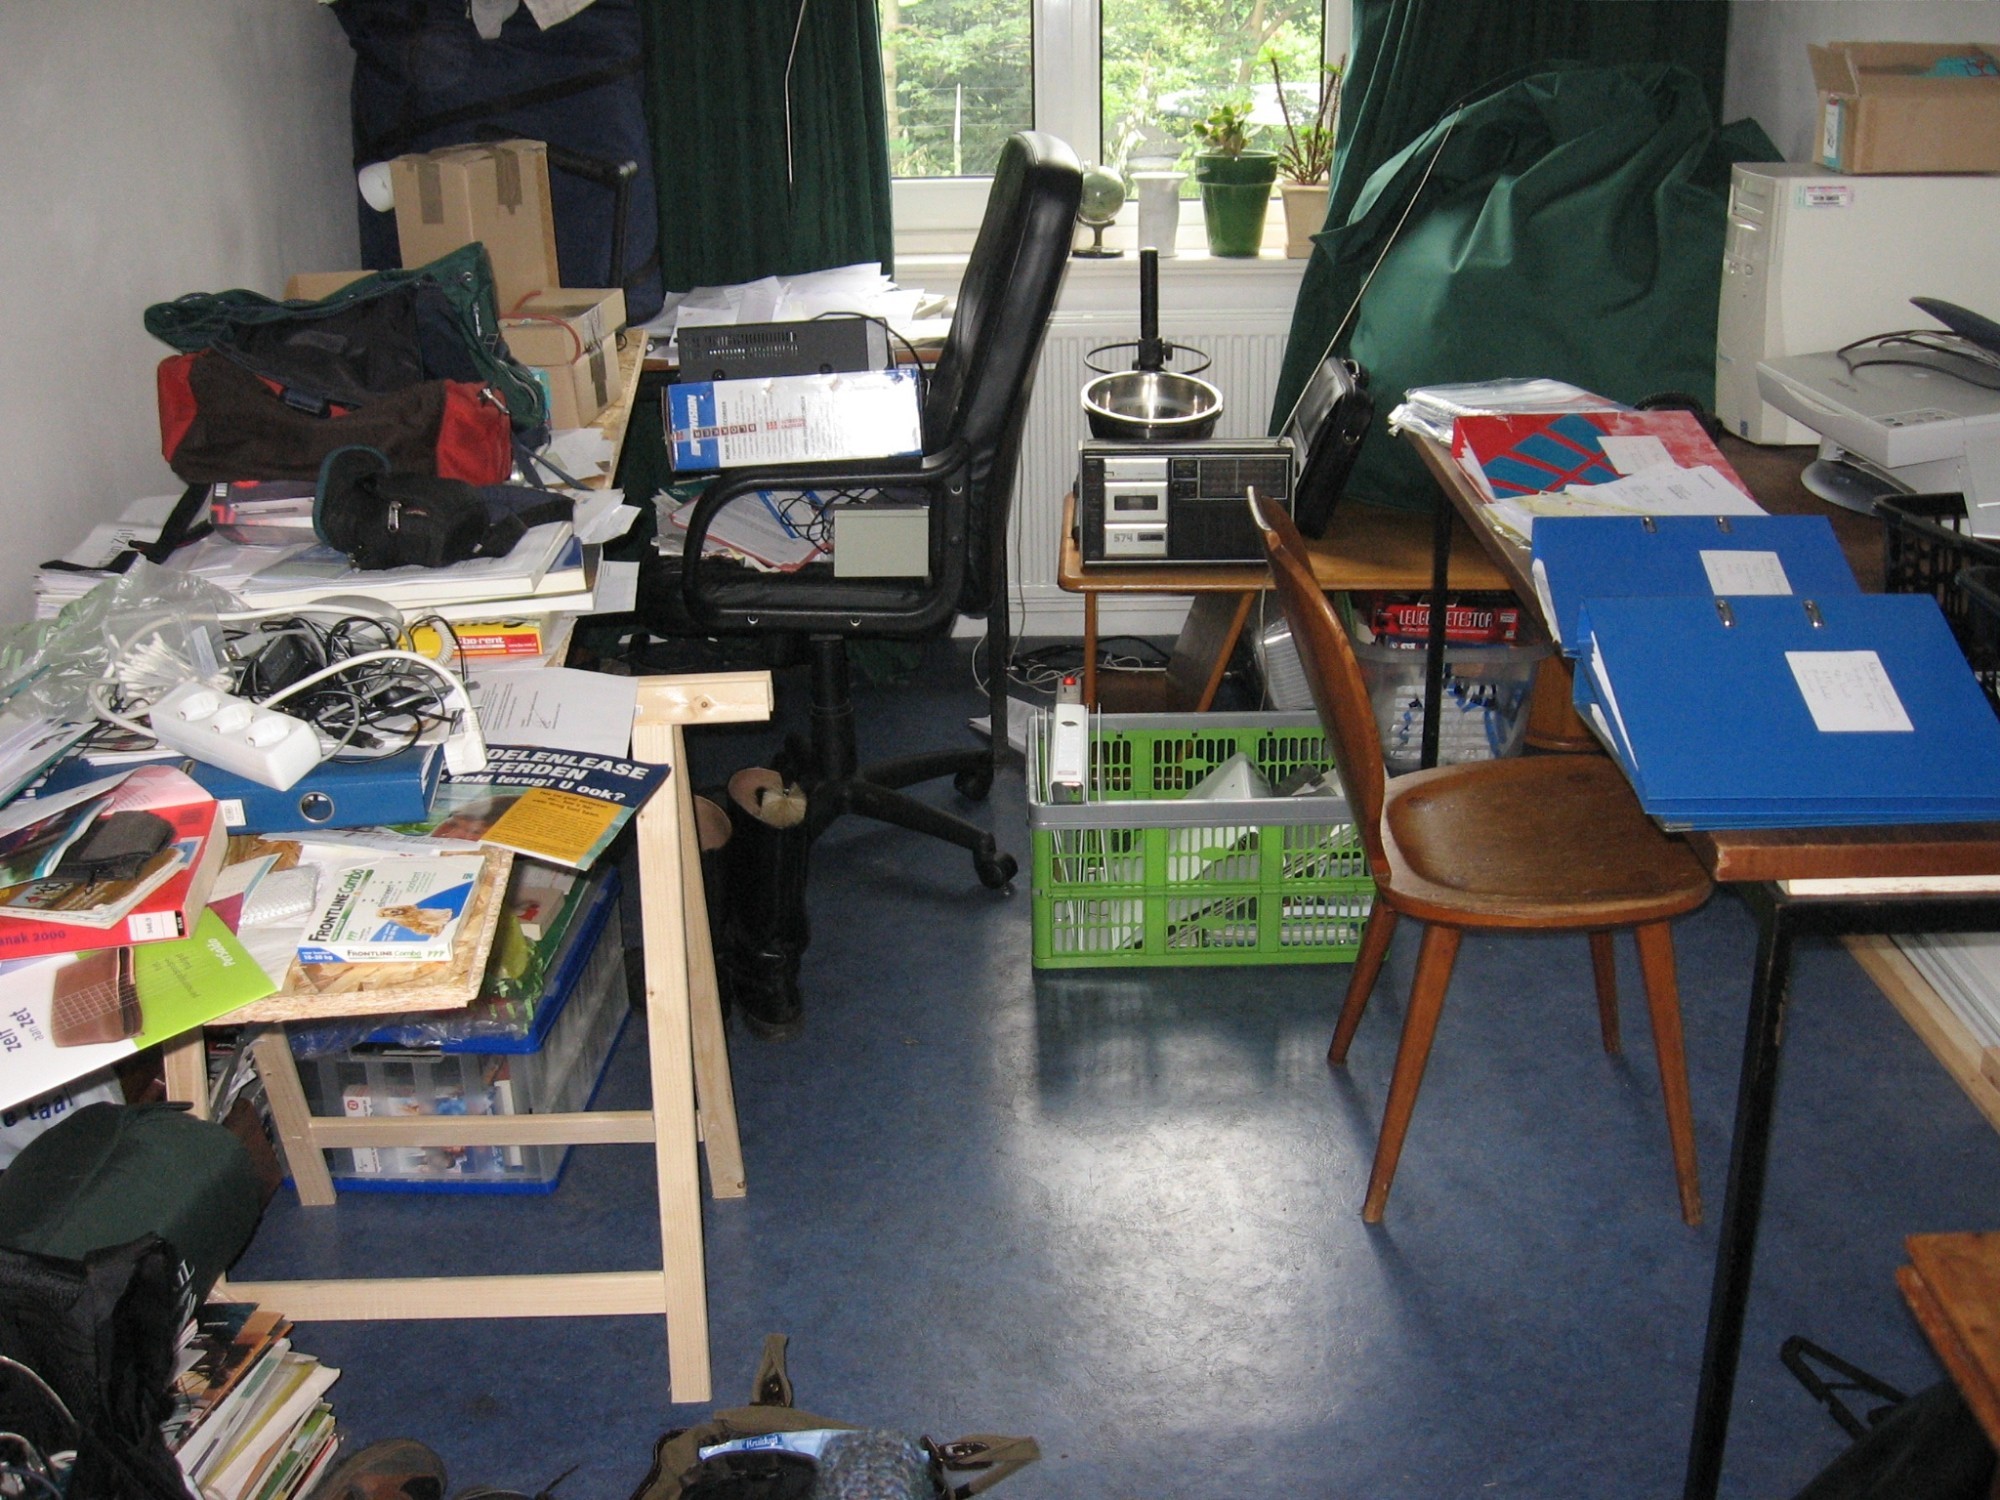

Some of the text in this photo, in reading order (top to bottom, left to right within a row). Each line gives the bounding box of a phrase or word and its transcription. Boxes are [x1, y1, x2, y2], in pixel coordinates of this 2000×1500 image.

[693, 423, 757, 438] BLOKKER
[1113, 533, 1133, 543] 574
[1399, 609, 1493, 628] LEUGEETECTOR
[483, 761, 589, 781] EERDEN
[487, 746, 649, 780] DELENLEASE
[449, 772, 493, 785] geld
[496, 773, 552, 788] terug!
[559, 780, 576, 790] U
[577, 785, 626, 802] ook?
[308, 888, 351, 942] FRONTLINE
[342, 867, 365, 895] Combo
[33, 930, 66, 942] 2000
[346, 949, 422, 957] FRONTLINE Combo
[9, 1007, 45, 1041] aan zet
